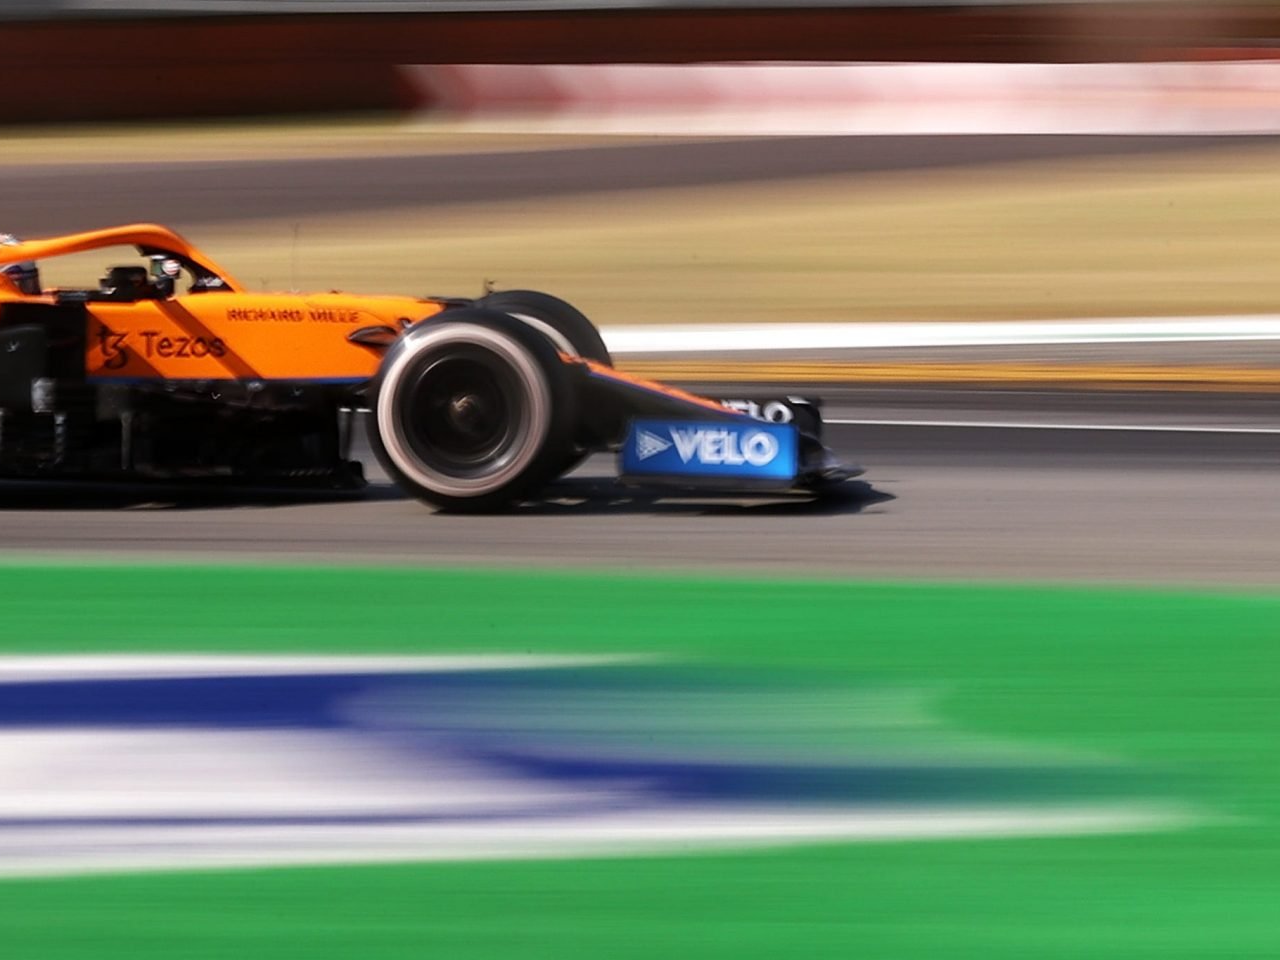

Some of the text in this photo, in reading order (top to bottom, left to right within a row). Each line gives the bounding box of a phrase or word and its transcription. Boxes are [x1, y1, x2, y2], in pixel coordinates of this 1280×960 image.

[226, 308, 303, 323] RICHARD
[140, 330, 227, 358] Tezos
[670, 426, 779, 467] VELO
